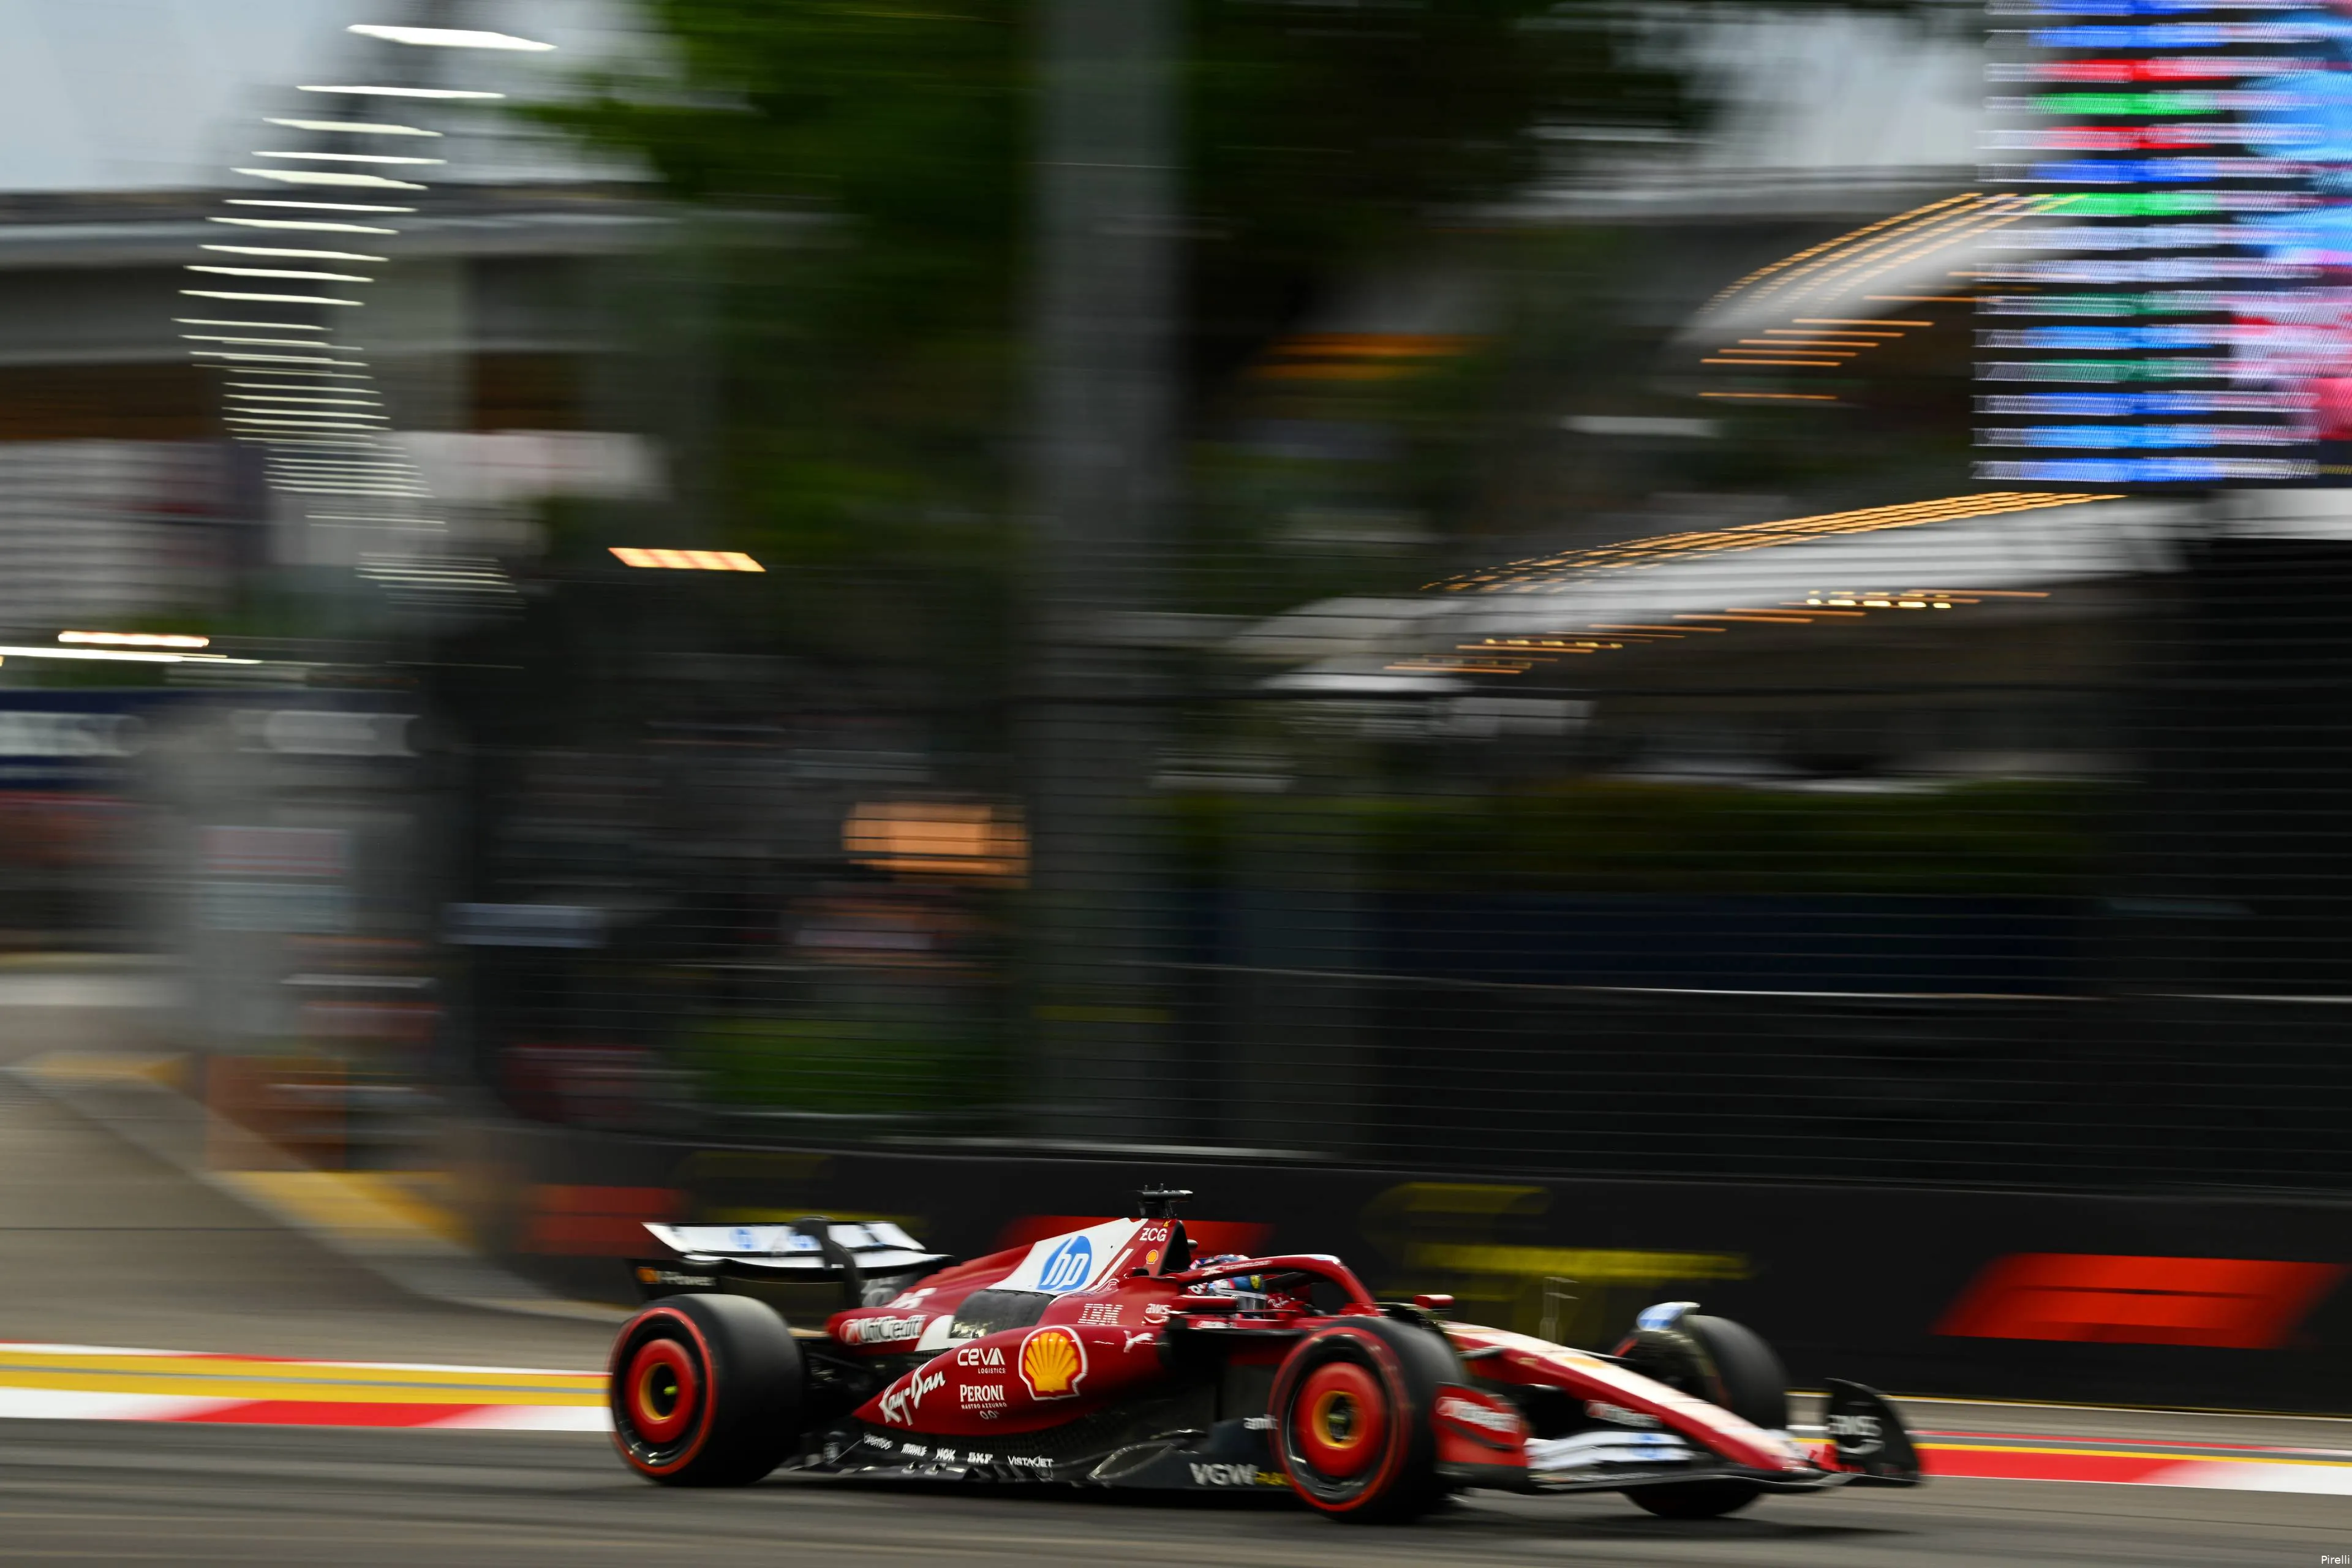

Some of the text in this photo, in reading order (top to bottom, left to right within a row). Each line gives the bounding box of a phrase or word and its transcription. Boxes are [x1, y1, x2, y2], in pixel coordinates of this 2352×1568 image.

[1139, 1227, 1167, 1242] ZCG
[1039, 1235, 1092, 1291] hp
[1077, 1303, 1124, 1325] IBM
[1145, 1303, 1172, 1315] aws
[878, 1359, 946, 1426] Ray-Ban
[960, 1384, 1005, 1402] PERONI
[1189, 1463, 1259, 1485] VGW
